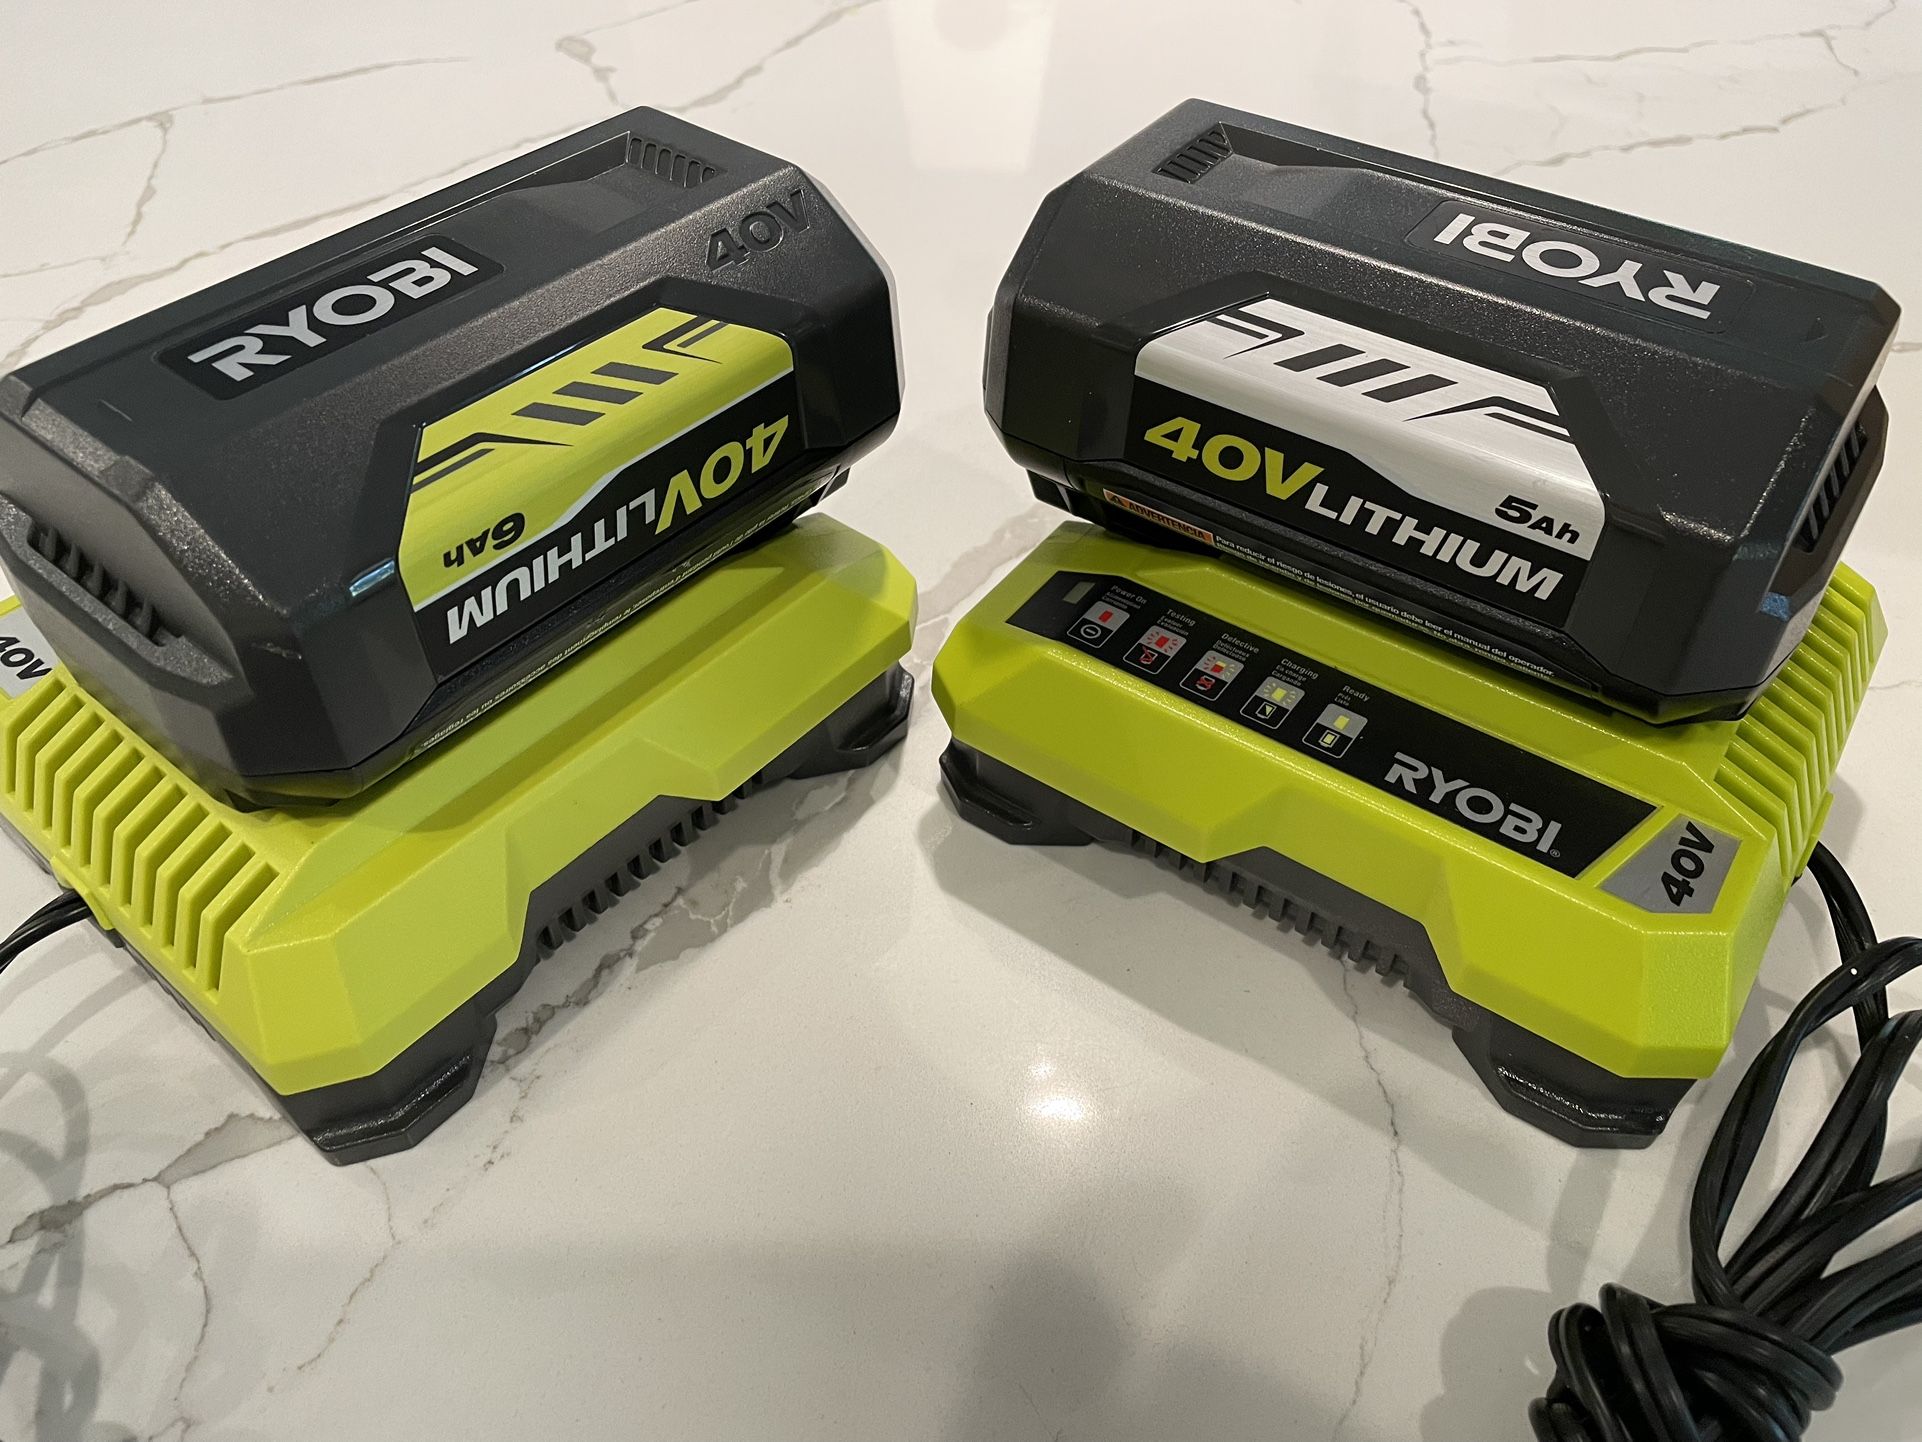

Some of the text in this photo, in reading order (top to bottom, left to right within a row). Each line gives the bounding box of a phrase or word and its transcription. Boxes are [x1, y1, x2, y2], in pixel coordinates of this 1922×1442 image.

[704, 188, 810, 273] 40V
[1433, 213, 1722, 320] RYOBI
[187, 245, 480, 383] RYOBI
[656, 415, 790, 534] 40V
[1143, 416, 1564, 600] 40V LITHIUM
[442, 512, 527, 570] 6Ah
[1128, 502, 1207, 540] ADVERTENCIA
[1494, 494, 1581, 545] 5Ah
[446, 487, 656, 645] LITHIUM
[1110, 585, 1147, 605] Power On
[1216, 535, 1235, 549] Para
[1236, 545, 1266, 561] reducir
[1276, 560, 1303, 577] riesgo
[1304, 572, 1316, 581] de
[1365, 597, 1400, 615] usuario
[1401, 611, 1424, 624] debe
[1425, 620, 1443, 632] leer
[1454, 633, 1490, 651] manual
[1491, 648, 1507, 658] del
[1167, 609, 1196, 627] Testing
[1221, 633, 1260, 654] Defective
[1281, 658, 1319, 681] Charging
[1343, 685, 1370, 702] Ready
[1660, 821, 1715, 907] 40V
